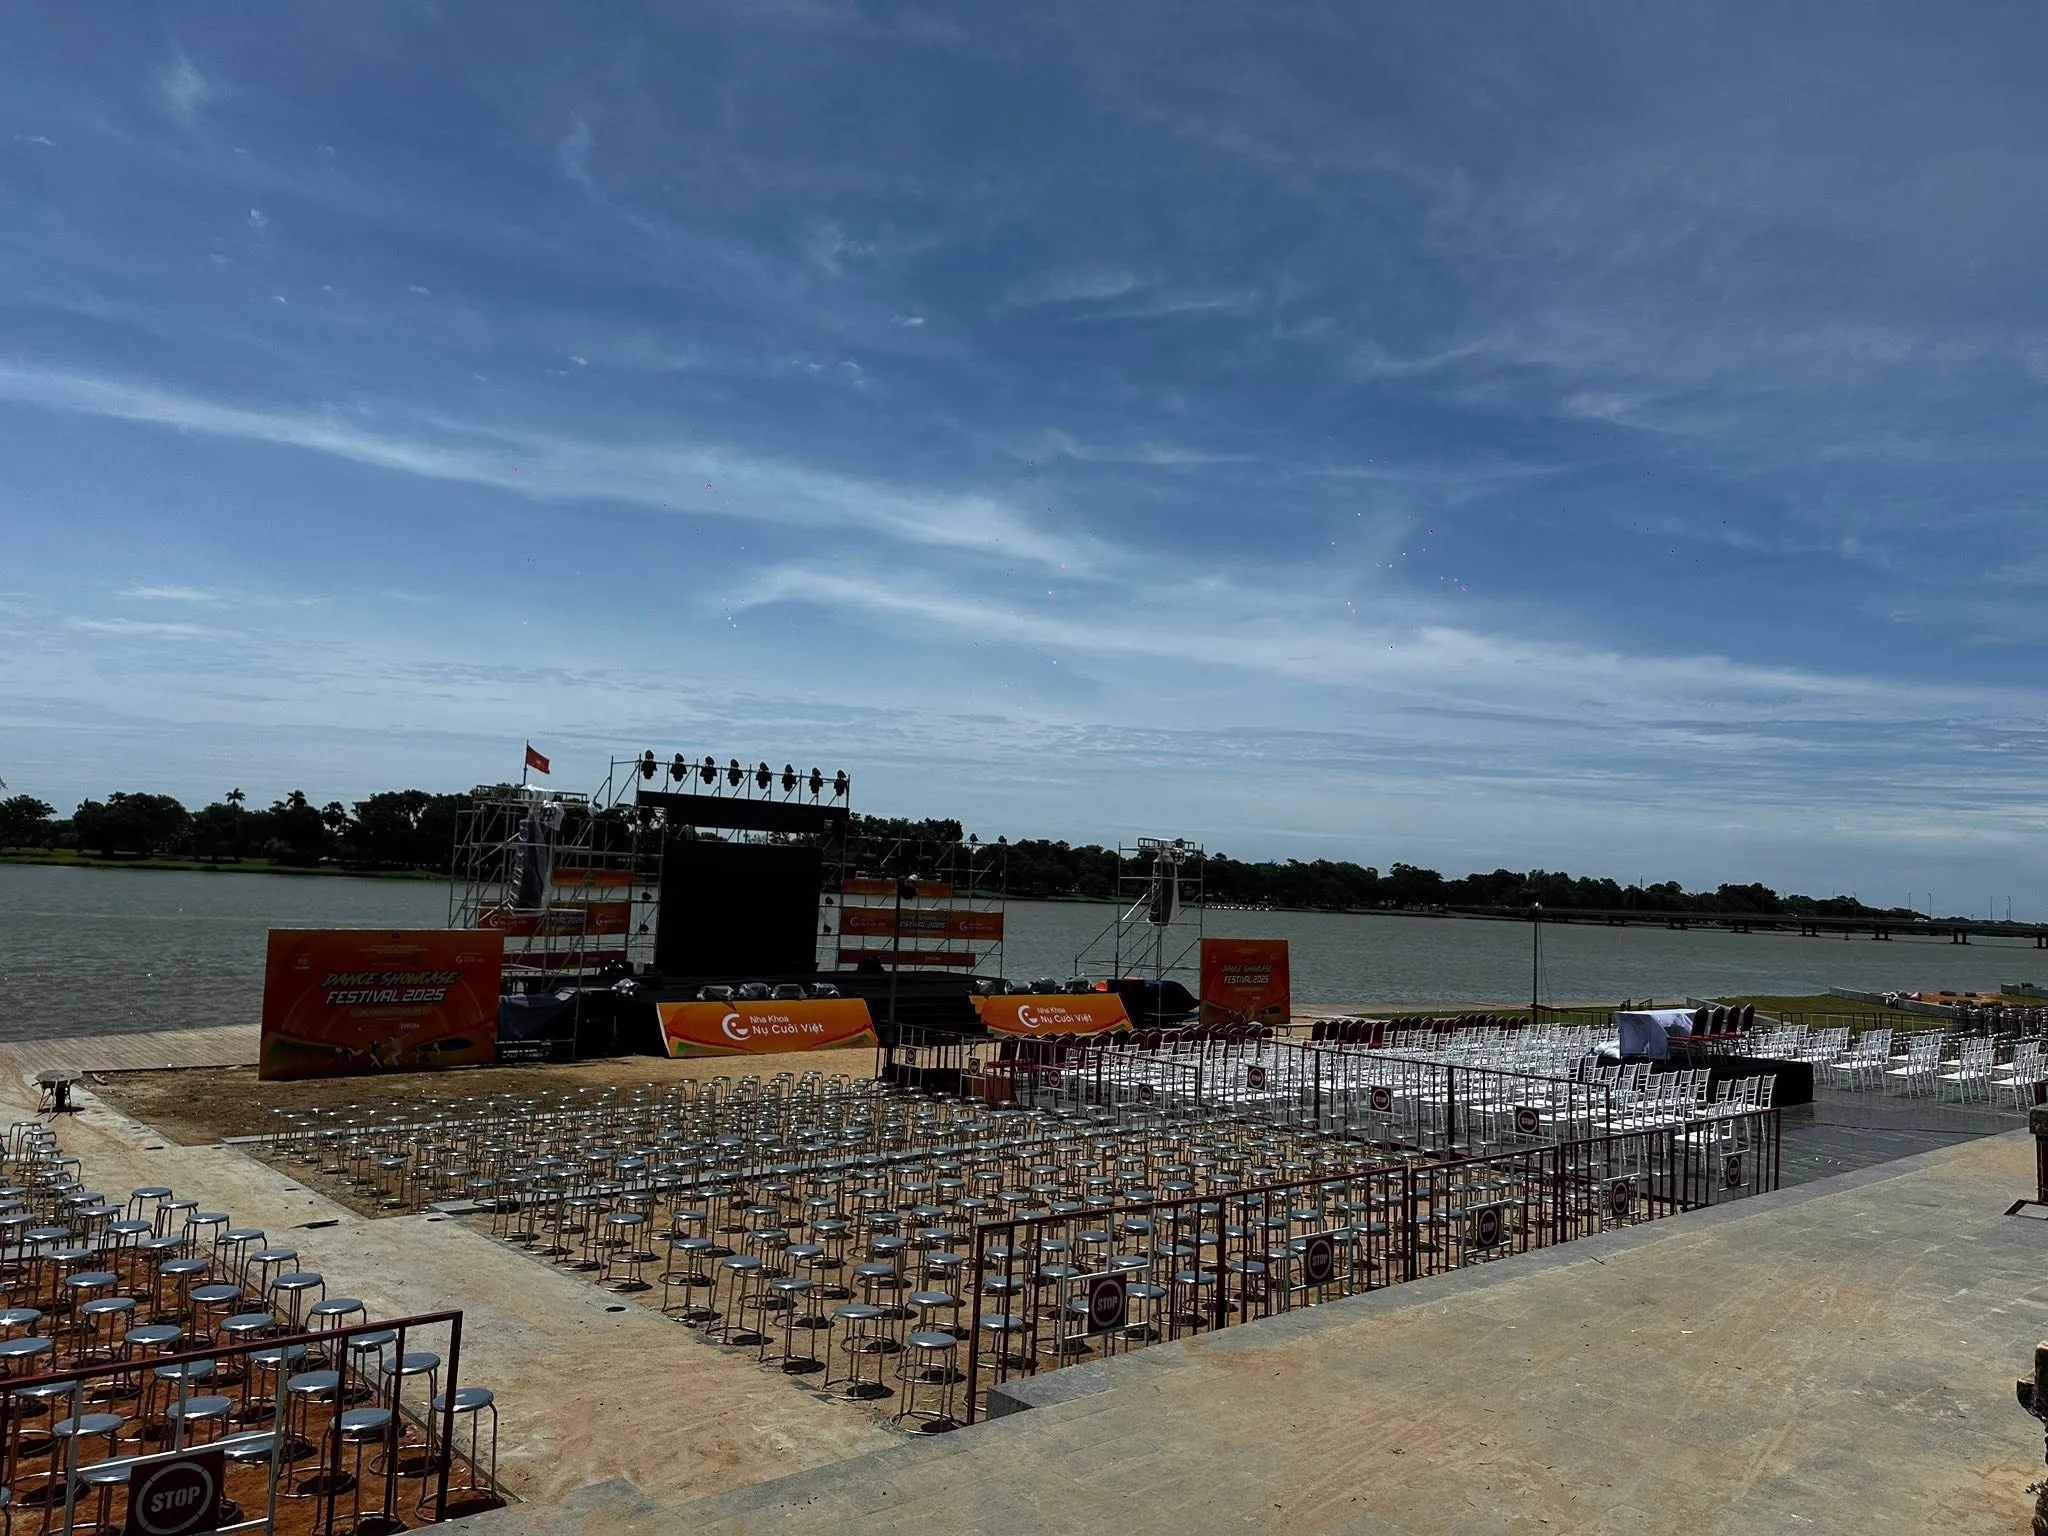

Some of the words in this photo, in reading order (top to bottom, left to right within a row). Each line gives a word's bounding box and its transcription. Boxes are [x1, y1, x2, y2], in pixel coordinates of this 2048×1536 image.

[321, 971, 379, 987] DANCE
[378, 970, 460, 986] SHOWCASE
[326, 989, 400, 1004] FESTIVAL
[403, 988, 446, 1002] 2025
[749, 1015, 767, 1024] Nha
[768, 1014, 789, 1023] Khoa
[752, 1025, 769, 1036] Nụ
[800, 1022, 824, 1035] Việt
[1521, 1117, 1535, 1125] STOP
[1481, 1221, 1495, 1233] STOP
[1311, 1252, 1328, 1267] STOP
[1097, 1296, 1118, 1312] STOP
[150, 1485, 200, 1513] STOP
